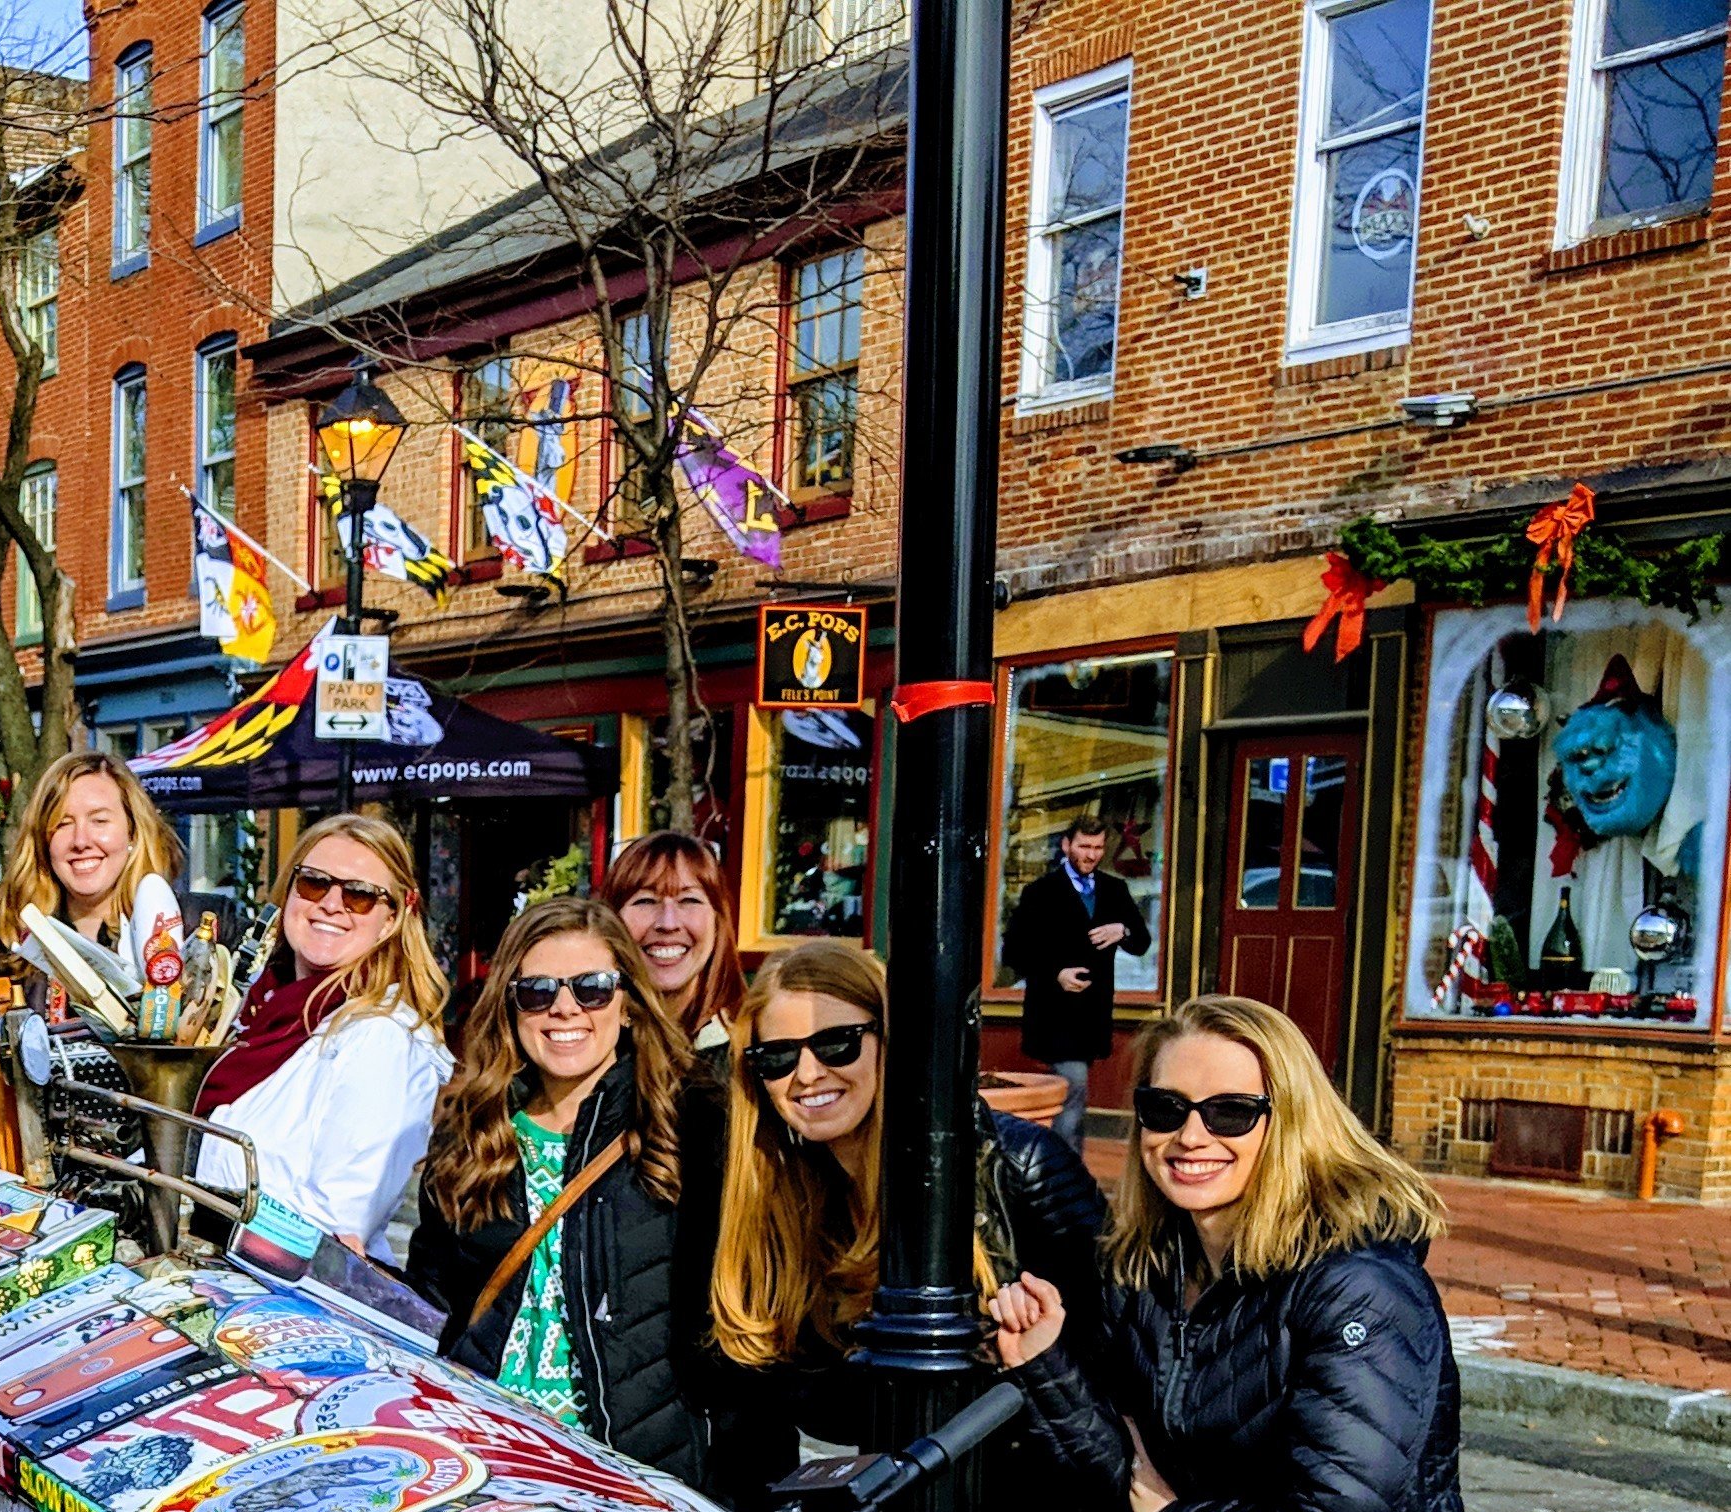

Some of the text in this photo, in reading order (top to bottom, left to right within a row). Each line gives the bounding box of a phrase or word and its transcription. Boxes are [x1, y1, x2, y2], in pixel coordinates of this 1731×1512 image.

[766, 612, 860, 643] E.C. POPS
[327, 683, 375, 696] PAY TO
[333, 697, 368, 710] PARK
[24, 1267, 119, 1314] CREEK
[44, 1419, 95, 1449] HOP
[97, 1401, 135, 1424] ON
[134, 1380, 187, 1406] THE
[186, 1363, 240, 1386] BUS
[398, 1408, 552, 1450] BRAU
[224, 1444, 322, 1484] ANCHOR
[410, 1457, 462, 1496] LAGER
